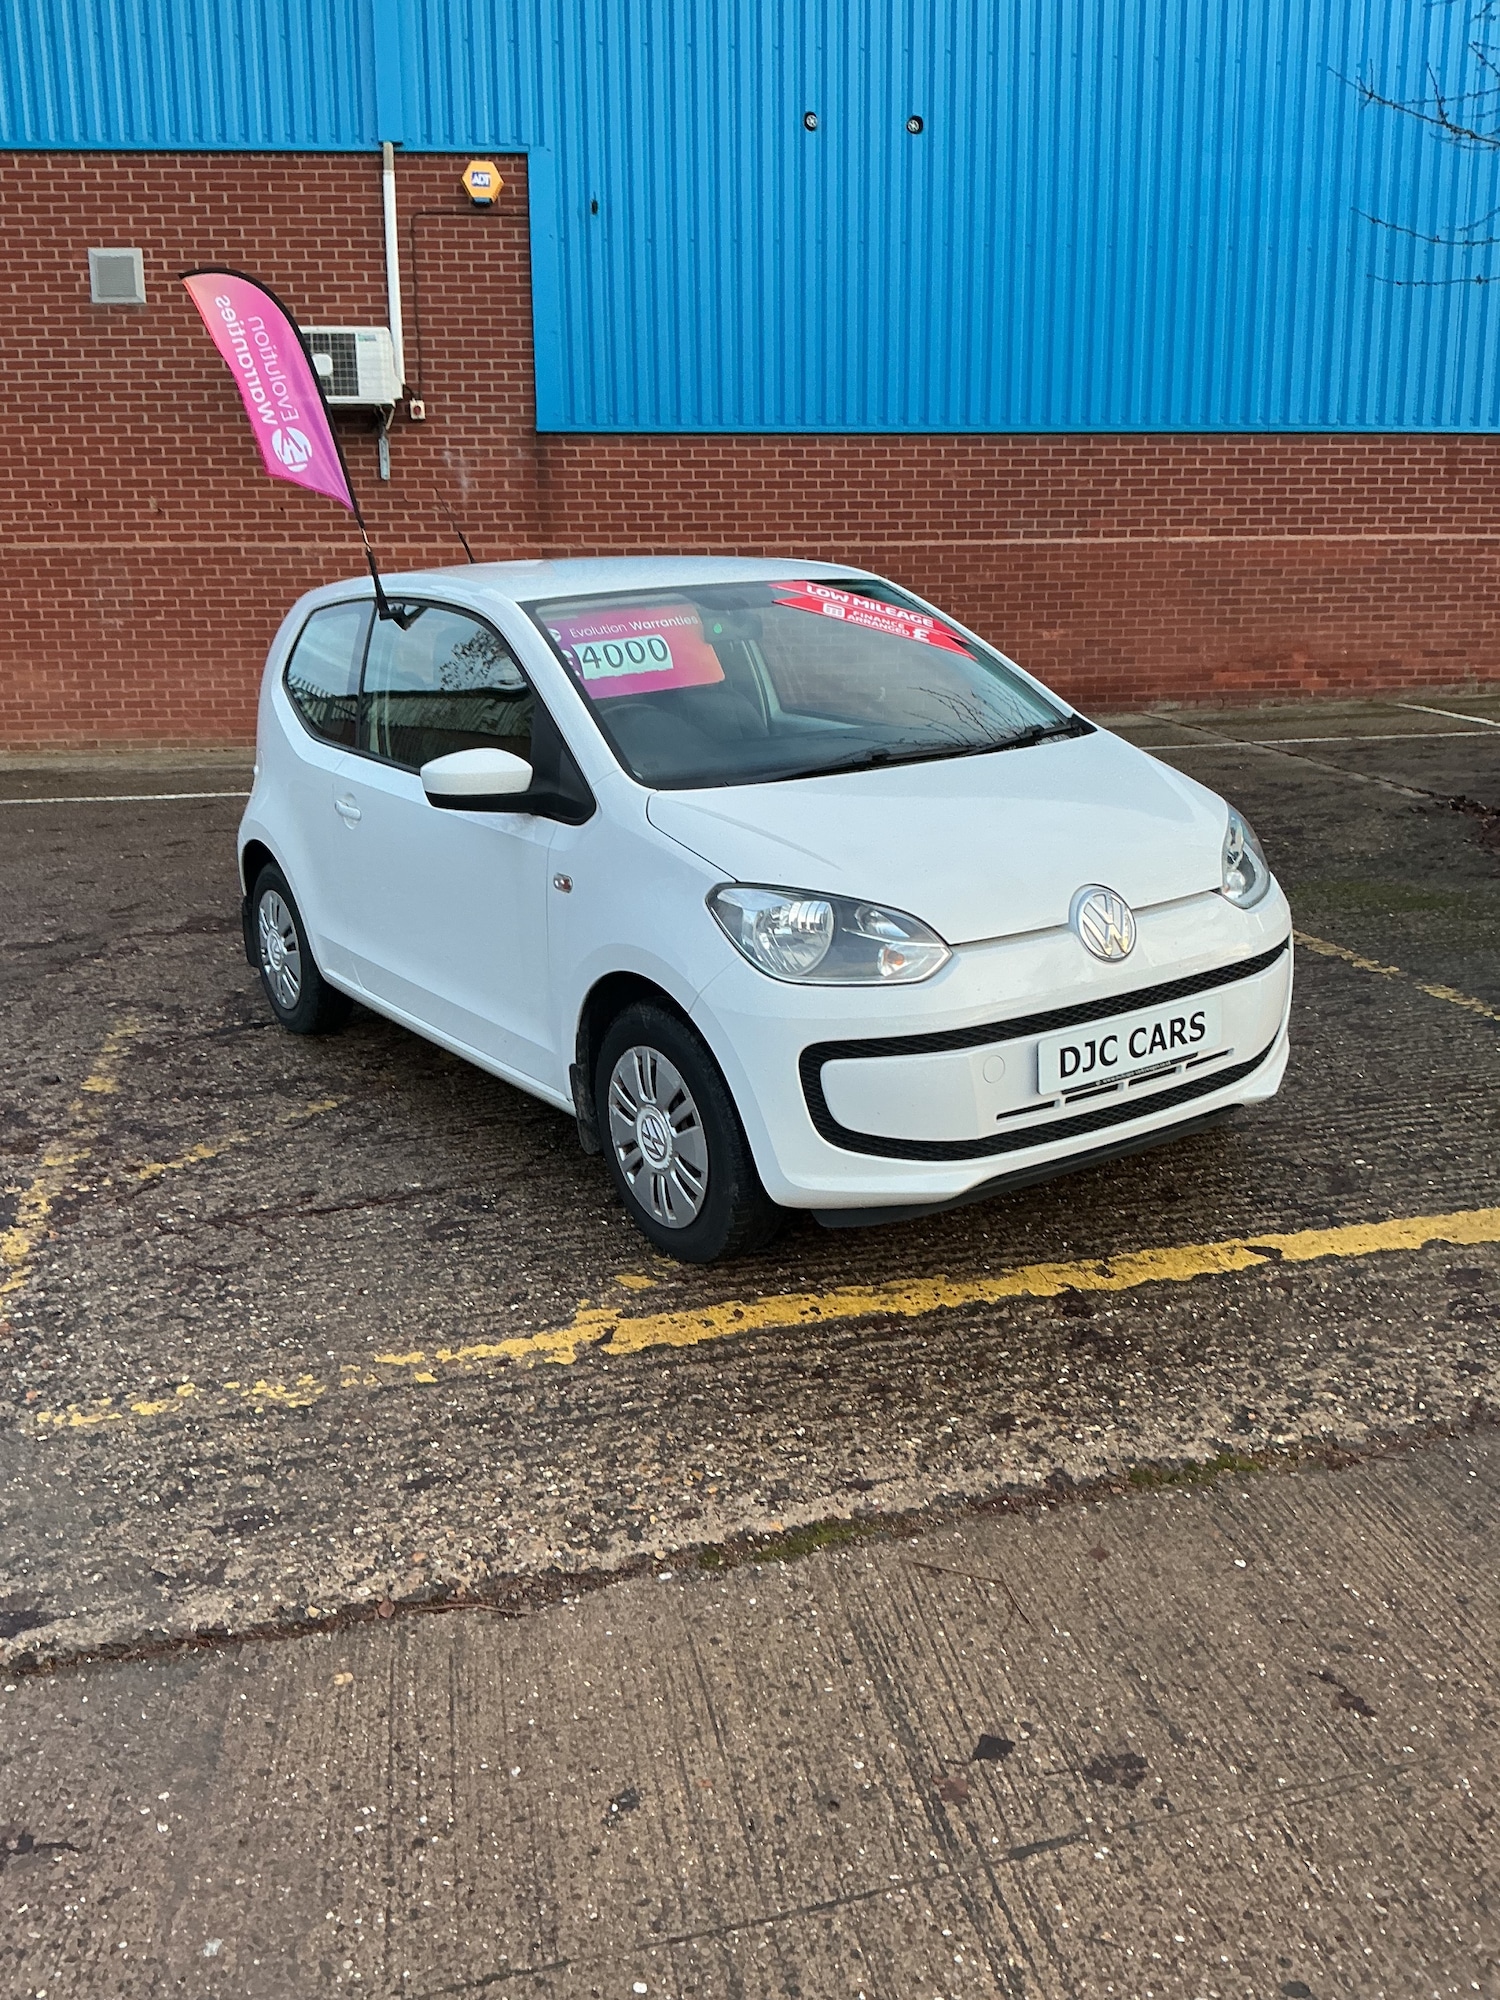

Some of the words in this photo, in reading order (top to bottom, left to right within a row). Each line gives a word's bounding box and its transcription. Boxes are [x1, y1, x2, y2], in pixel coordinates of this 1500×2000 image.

[472, 172, 491, 186] ADT
[806, 584, 849, 603] LOW
[853, 596, 934, 628] MILEAGE
[570, 623, 628, 639] Evolution
[628, 615, 699, 631] Warranties
[846, 614, 911, 636] ARRANGED
[852, 610, 905, 629] FINANCE
[913, 627, 930, 643] £
[1060, 1035, 1118, 1078] DJC
[1128, 1011, 1206, 1059] CARS
